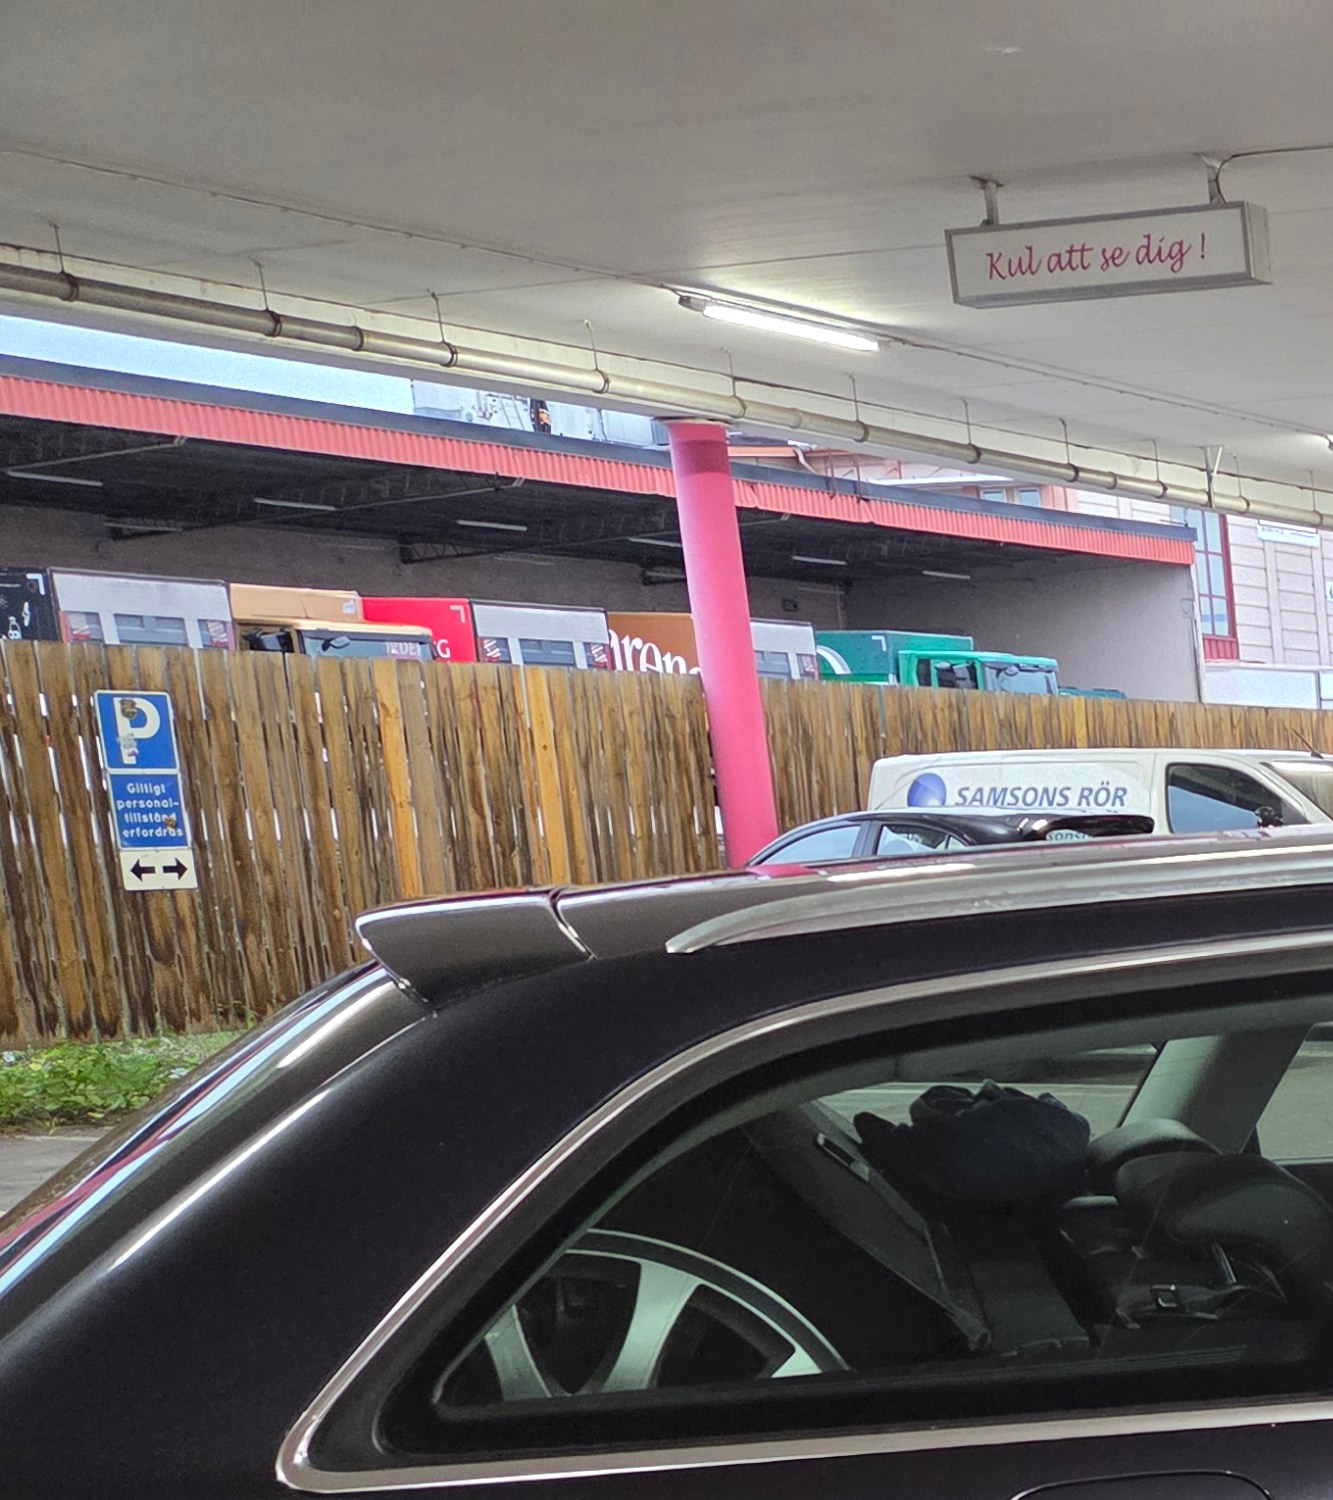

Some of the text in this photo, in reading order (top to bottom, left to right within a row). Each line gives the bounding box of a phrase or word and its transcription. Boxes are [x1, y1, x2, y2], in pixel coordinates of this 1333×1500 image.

[986, 246, 1043, 280] Kul
[1047, 243, 1095, 274] att
[1100, 246, 1131, 271] se
[1135, 233, 1192, 273] dig
[113, 697, 161, 765] P
[126, 782, 166, 797] Giltigt
[955, 781, 1128, 808] SAMSONS RÖR
[116, 797, 180, 811] personal-
[122, 826, 184, 838] erfordras
